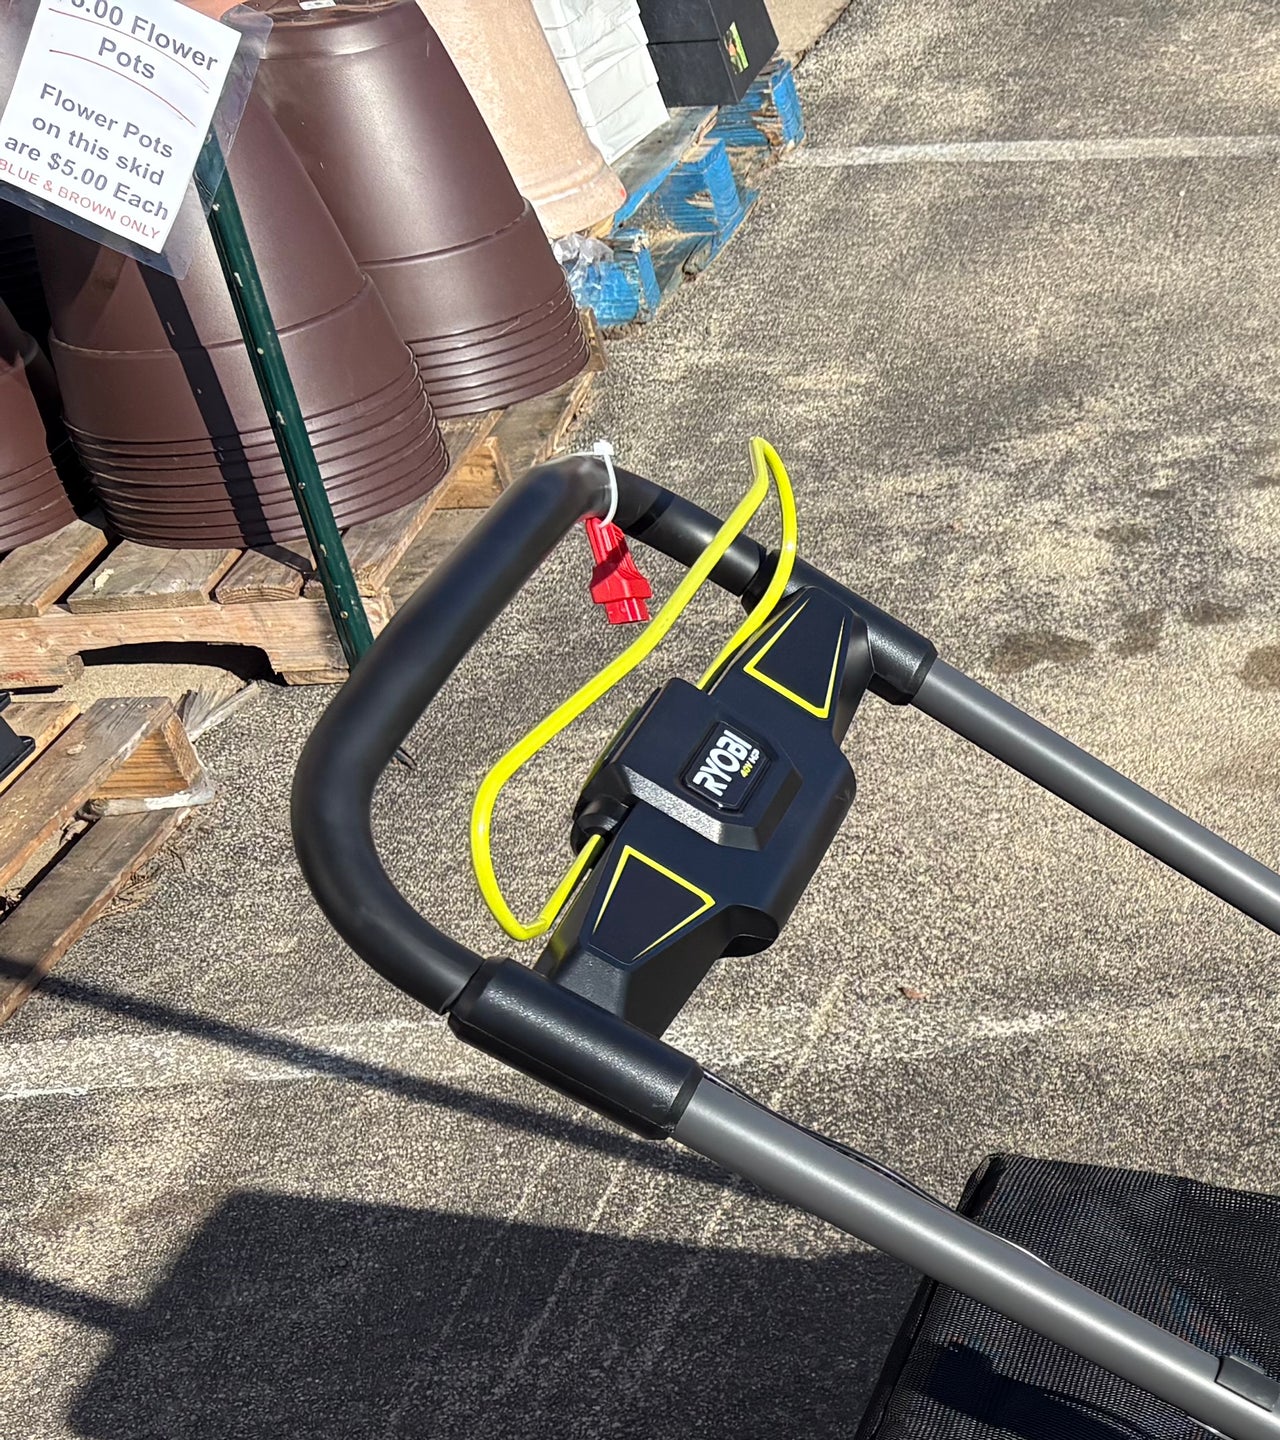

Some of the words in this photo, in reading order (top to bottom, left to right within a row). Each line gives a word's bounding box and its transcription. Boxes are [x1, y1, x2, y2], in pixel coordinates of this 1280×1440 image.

[98, 37, 156, 79] Pots
[131, 15, 218, 71] Flower
[32, 117, 61, 139] on
[68, 130, 109, 161] this
[116, 155, 165, 186] skid
[40, 83, 118, 131] Flower
[123, 122, 173, 158] Pots
[0, 158, 40, 185] BLUE
[43, 180, 54, 193] &
[58, 186, 116, 221] BROWN
[120, 215, 161, 239] ONLY
[5, 137, 41, 161] are
[48, 152, 108, 191] $5.00
[113, 182, 169, 221] Each
[692, 729, 752, 797] RYOBI
